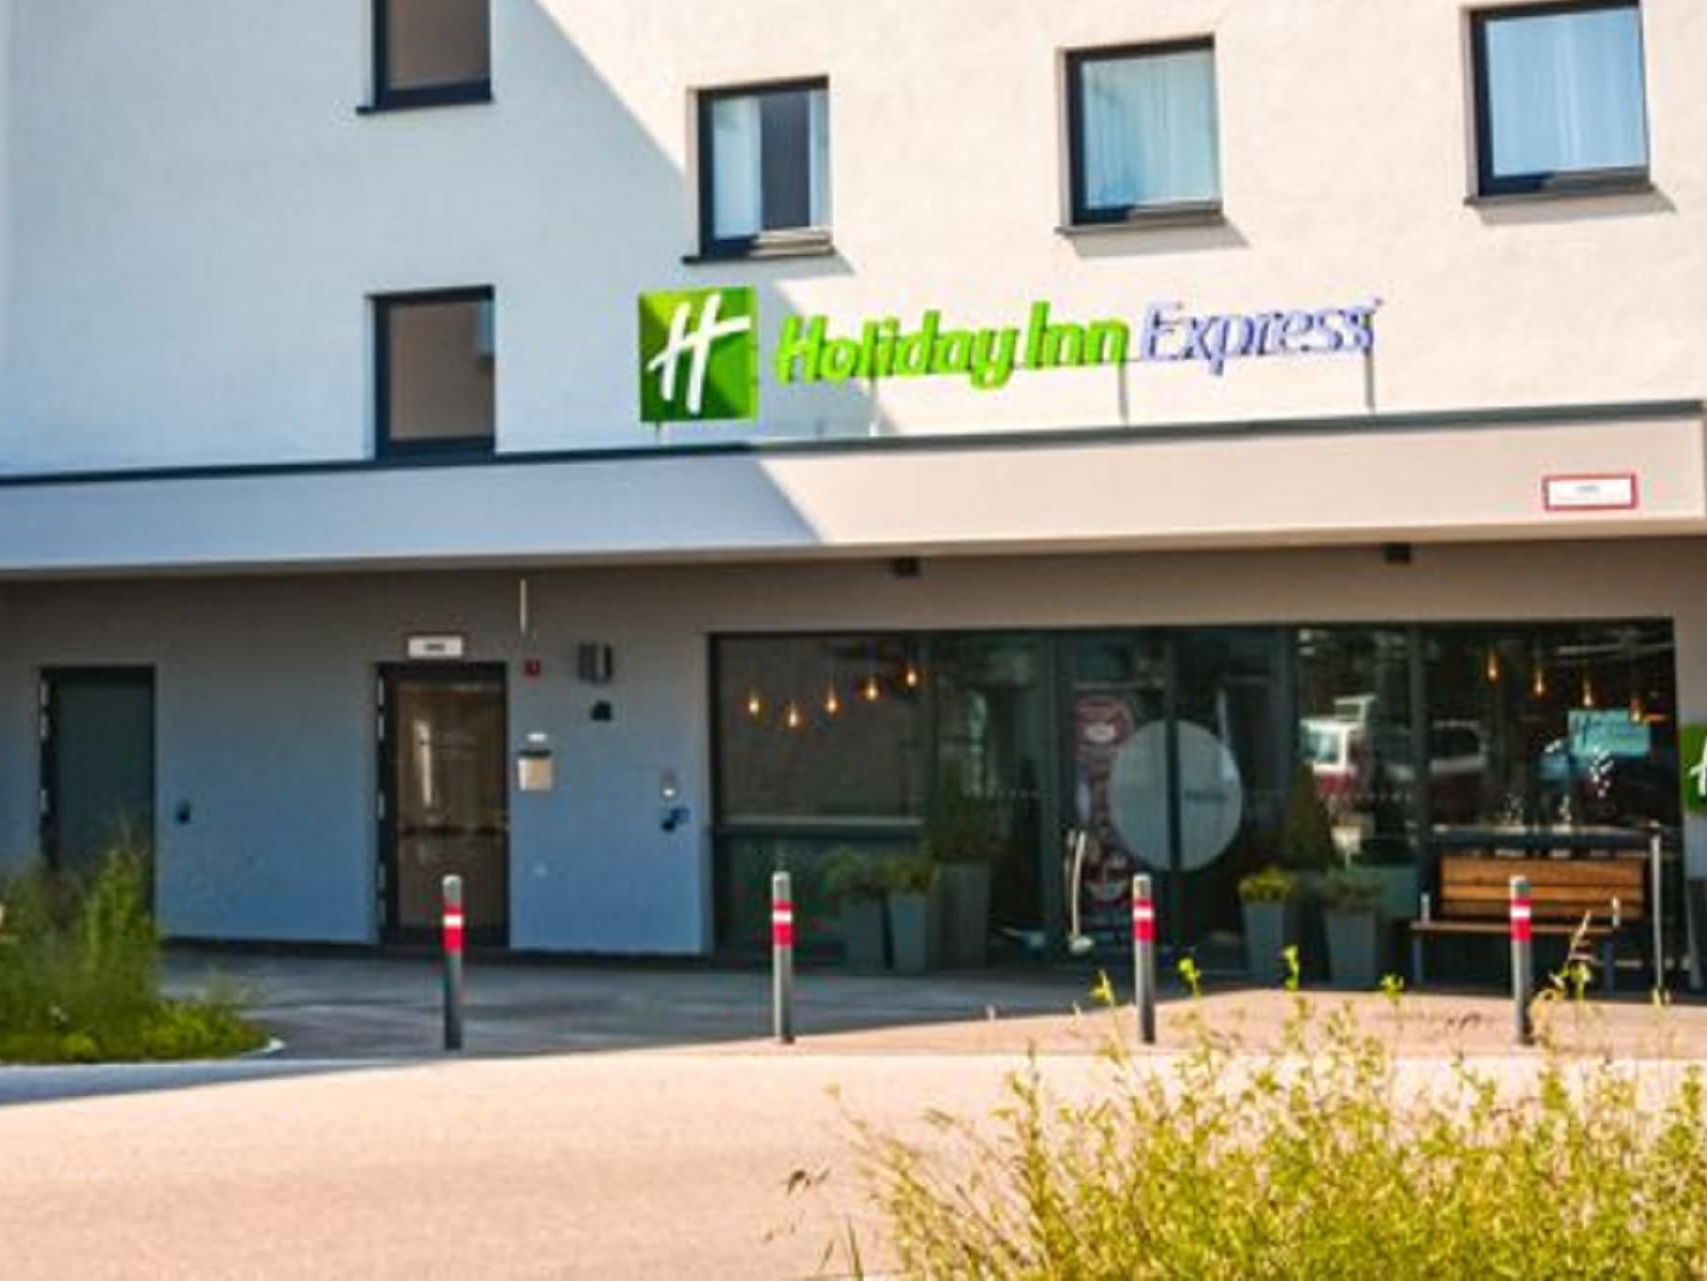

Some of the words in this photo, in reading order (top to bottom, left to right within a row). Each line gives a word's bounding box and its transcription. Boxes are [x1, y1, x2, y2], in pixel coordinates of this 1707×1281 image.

[776, 310, 1019, 389] Holiday
[1025, 300, 1129, 369] Inn
[1140, 300, 1376, 376] Express
